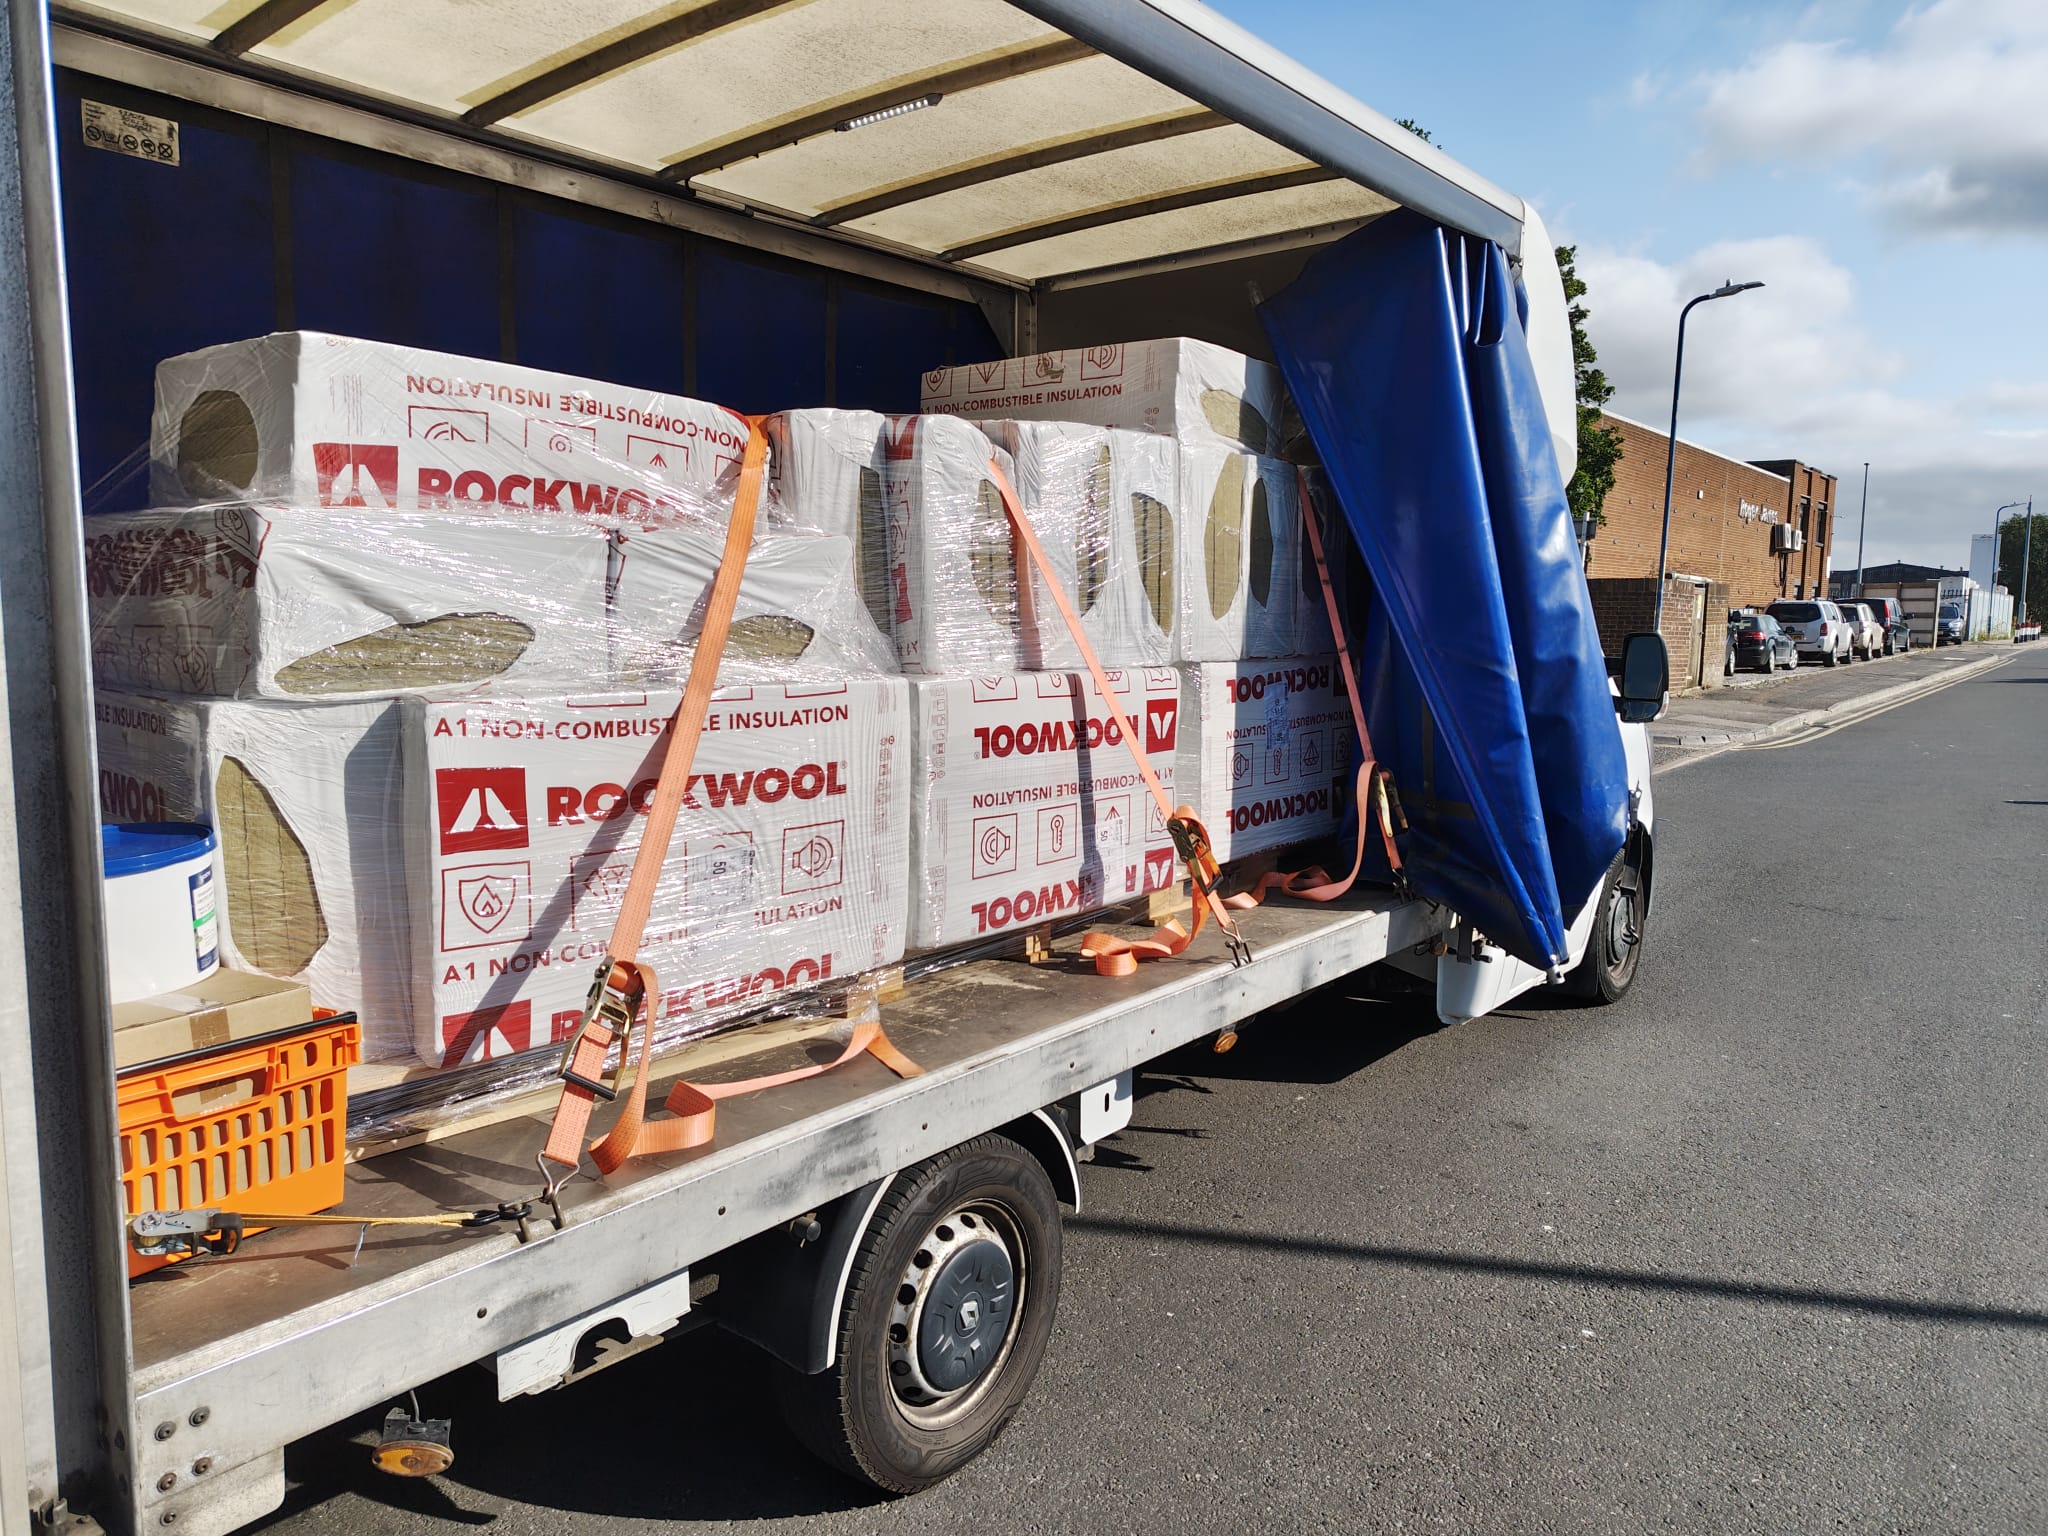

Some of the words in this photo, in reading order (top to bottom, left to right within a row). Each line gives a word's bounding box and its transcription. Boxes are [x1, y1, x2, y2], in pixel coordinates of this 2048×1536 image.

[406, 375, 551, 409] INSULATION
[934, 395, 1043, 414] NON-COMBUSTIBLE
[1047, 383, 1122, 403] INSULATION
[112, 705, 167, 736] INSULATION
[433, 716, 469, 738] A1
[729, 704, 849, 730] INSULATION
[1226, 724, 1266, 741] SULATION
[1056, 769, 1161, 797] NN-COMBUSTIBLE
[1164, 767, 1174, 779] A1
[973, 786, 1052, 809] INSULATION
[1226, 788, 1328, 834] ROCKWOOL
[712, 861, 727, 875] 50
[442, 961, 476, 985] A1
